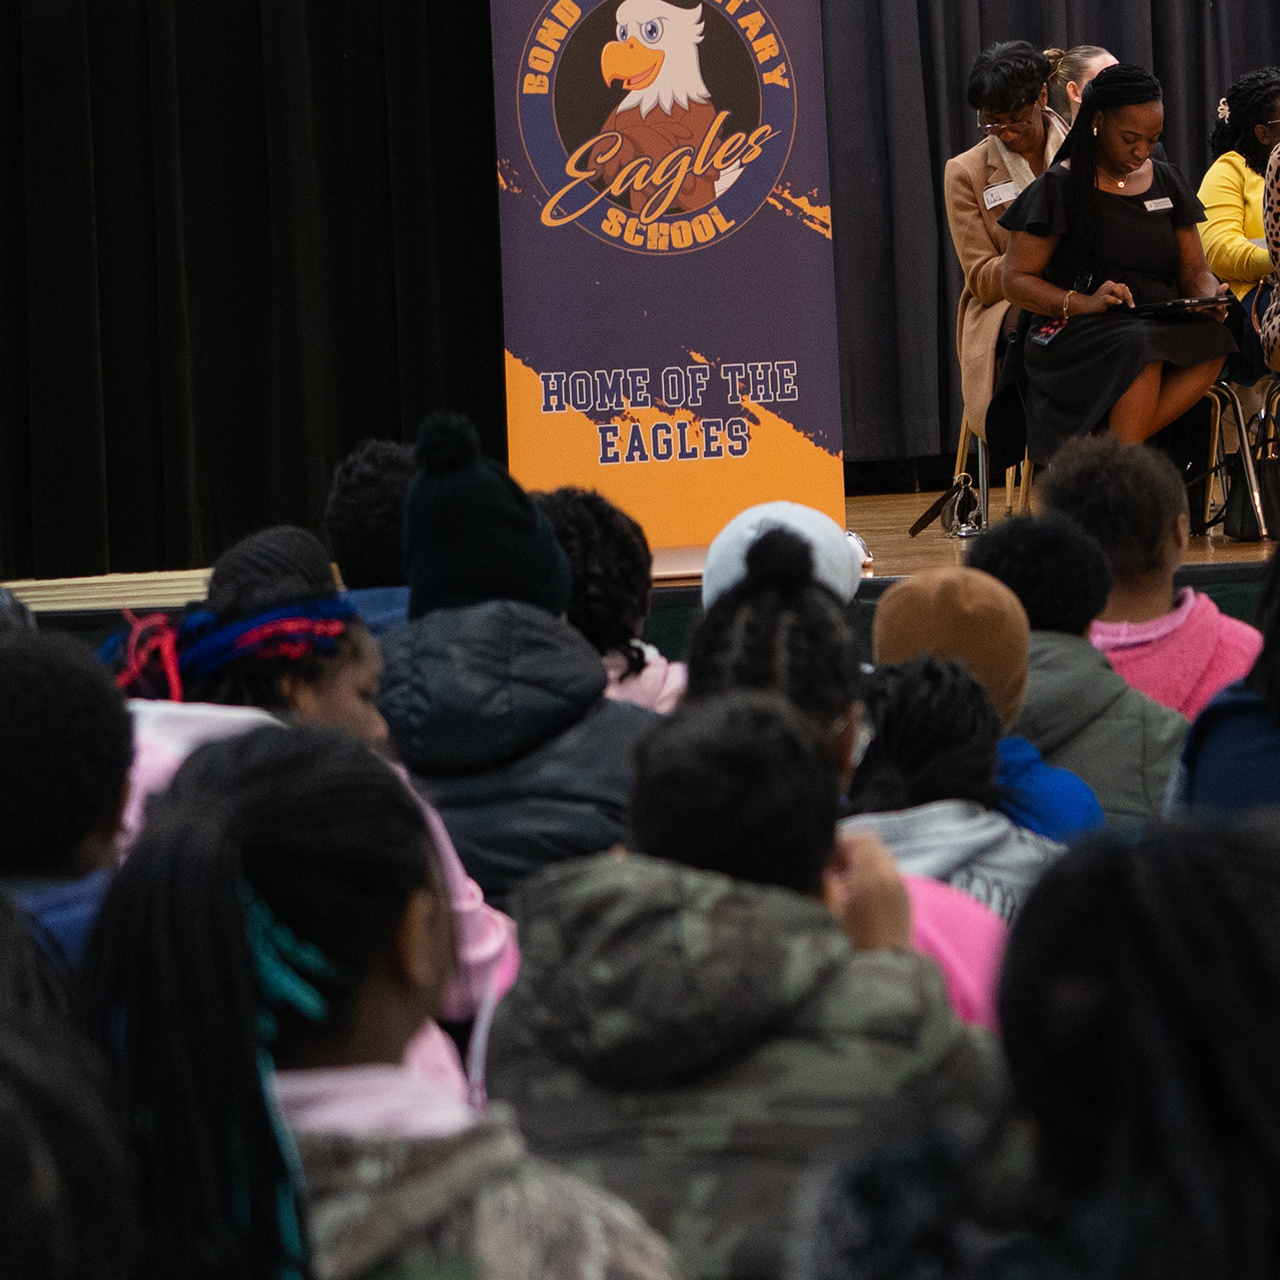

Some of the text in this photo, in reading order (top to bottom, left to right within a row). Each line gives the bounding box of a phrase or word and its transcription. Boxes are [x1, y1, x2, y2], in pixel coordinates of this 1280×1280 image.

[541, 111, 782, 227] Eagles
[601, 205, 735, 251] SCHOOL
[540, 360, 798, 413] HOME OF THE
[598, 417, 749, 465] EAGLES
